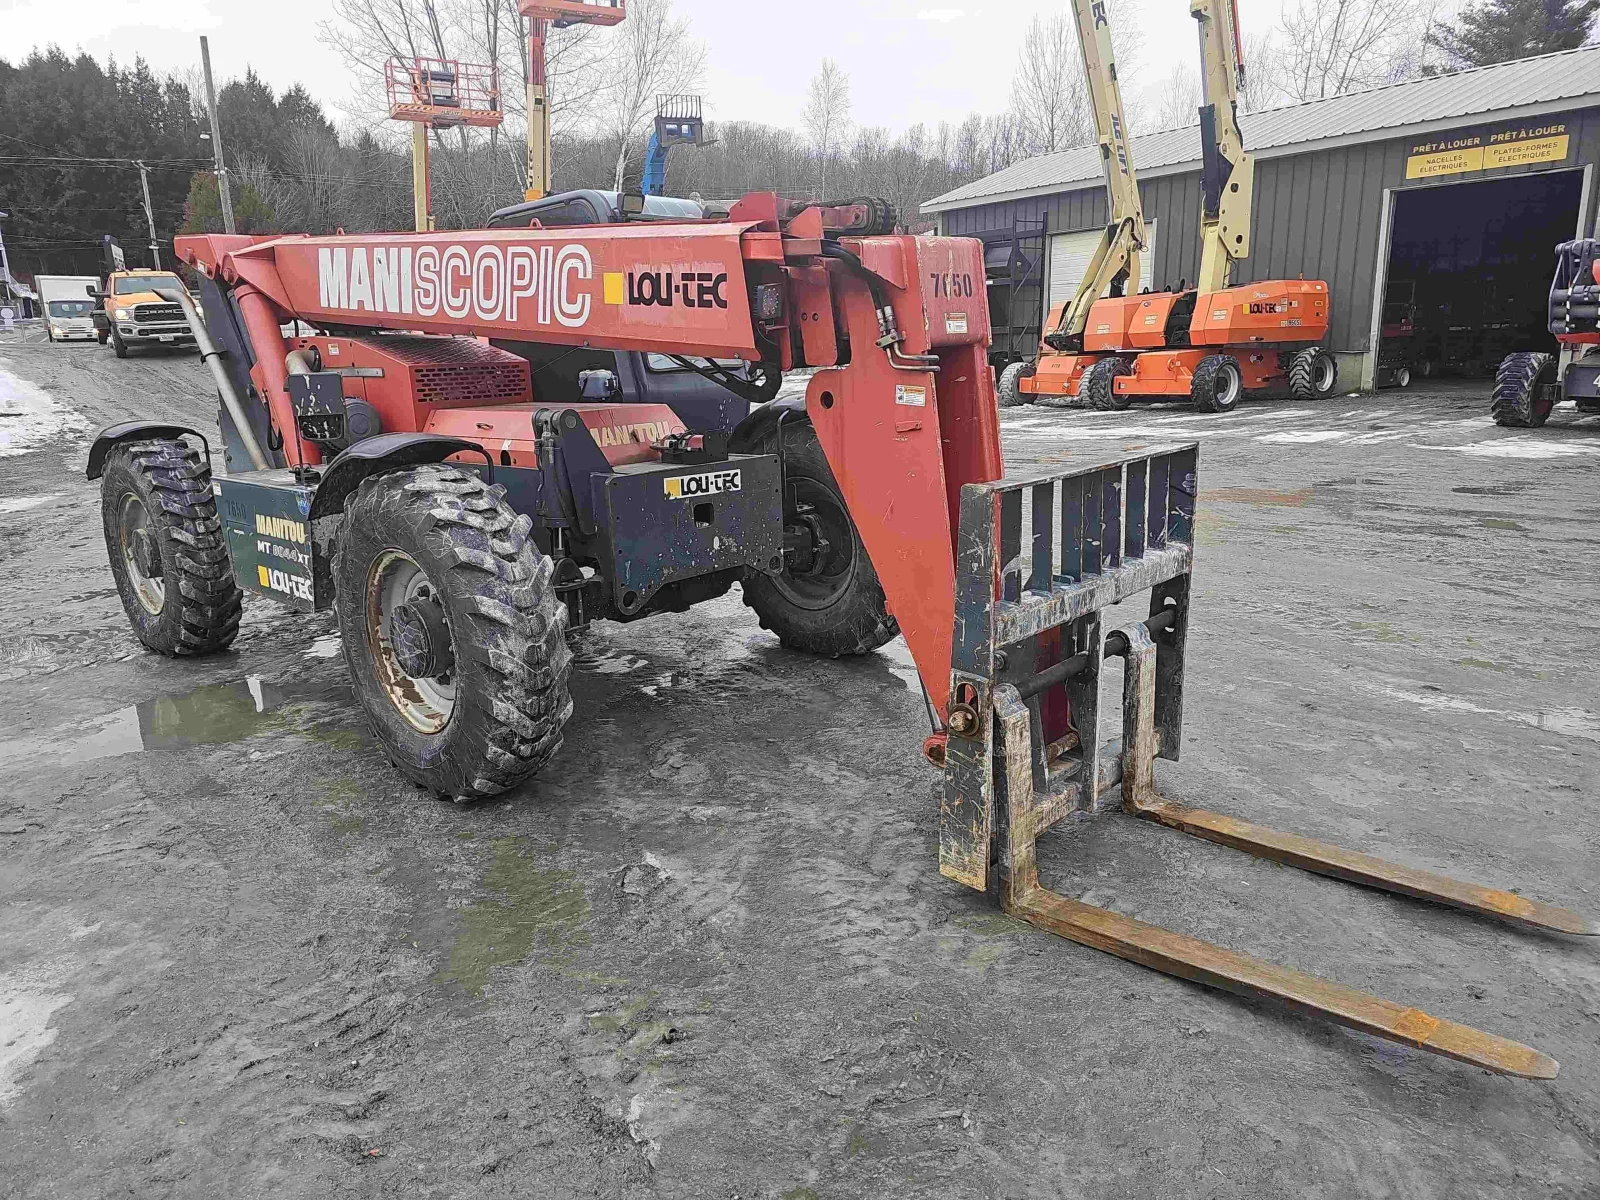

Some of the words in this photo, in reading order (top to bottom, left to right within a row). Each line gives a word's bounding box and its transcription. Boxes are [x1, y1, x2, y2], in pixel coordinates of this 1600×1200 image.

[1490, 130, 1518, 143] PRÊT
[1519, 128, 1527, 139] À
[1528, 124, 1566, 137] LOUER
[1412, 143, 1437, 154] PRÊT
[1439, 140, 1446, 150] À
[1447, 137, 1481, 149] LOUER
[1493, 141, 1559, 156] PLATES-FORMES
[1419, 161, 1468, 173] ÉLECTRIQUES
[1426, 154, 1463, 165] NACELLES
[318, 244, 592, 329] MANISCOPIC
[628, 271, 728, 309] LOU-TEC
[1249, 303, 1277, 314] LOU-TEC
[681, 471, 739, 496] LOU-TEC
[256, 513, 306, 544] MANITOU
[257, 540, 271, 554] MT
[268, 567, 314, 602] LOU-TEC
